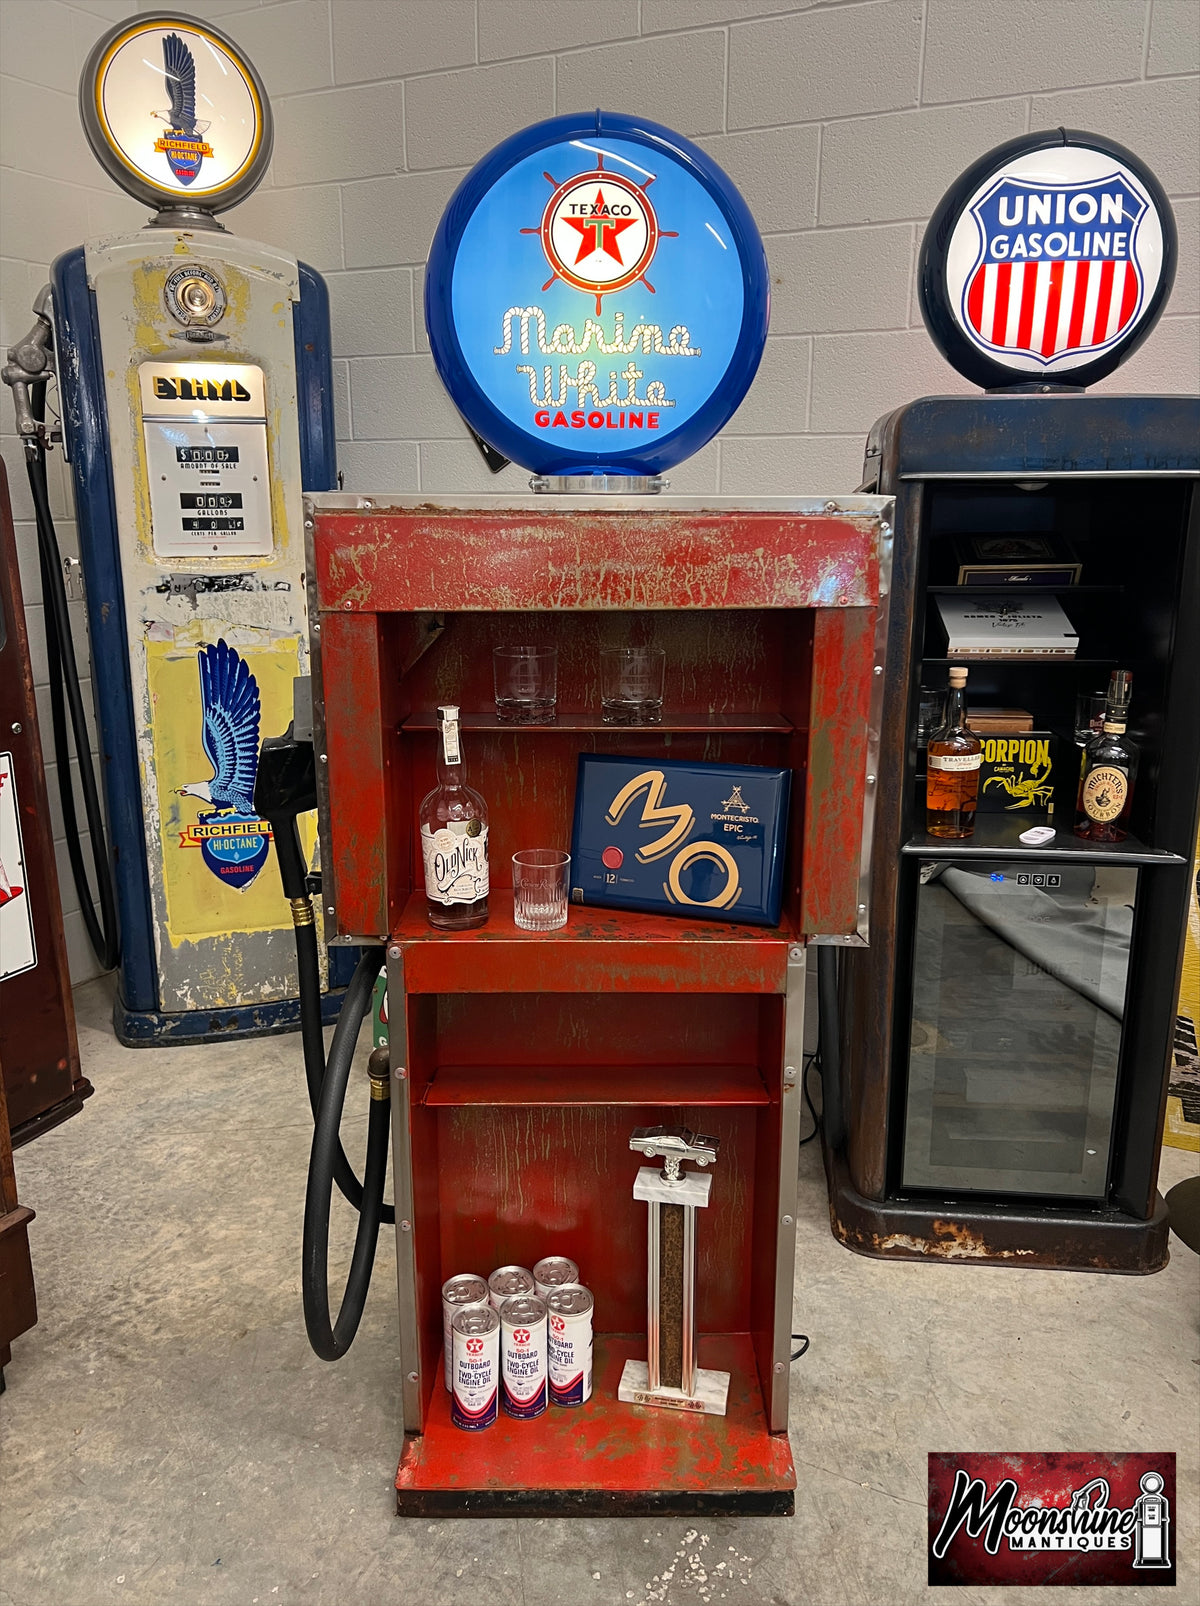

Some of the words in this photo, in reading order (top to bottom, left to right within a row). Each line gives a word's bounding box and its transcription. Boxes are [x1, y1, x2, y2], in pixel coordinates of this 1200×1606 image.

[159, 140, 208, 151] RICHFIELD
[569, 203, 632, 217] TEXACO
[999, 192, 1123, 226] UNION
[990, 231, 1128, 259] GASOLINE
[494, 306, 702, 357] Marine
[152, 376, 250, 401] ETHYL
[517, 360, 676, 408] White
[534, 410, 660, 430] GASOLINE
[1088, 772, 1123, 794] MICHTER'S
[710, 813, 758, 824] MONTECRISTO
[723, 823, 743, 832] EPIC
[220, 865, 254, 874] GASOLINE
[606, 873, 616, 884] 12
[507, 1350, 538, 1359] OUTBOARD
[459, 1360, 490, 1370] OUTBOARD
[459, 1376, 480, 1386] ENGINE
